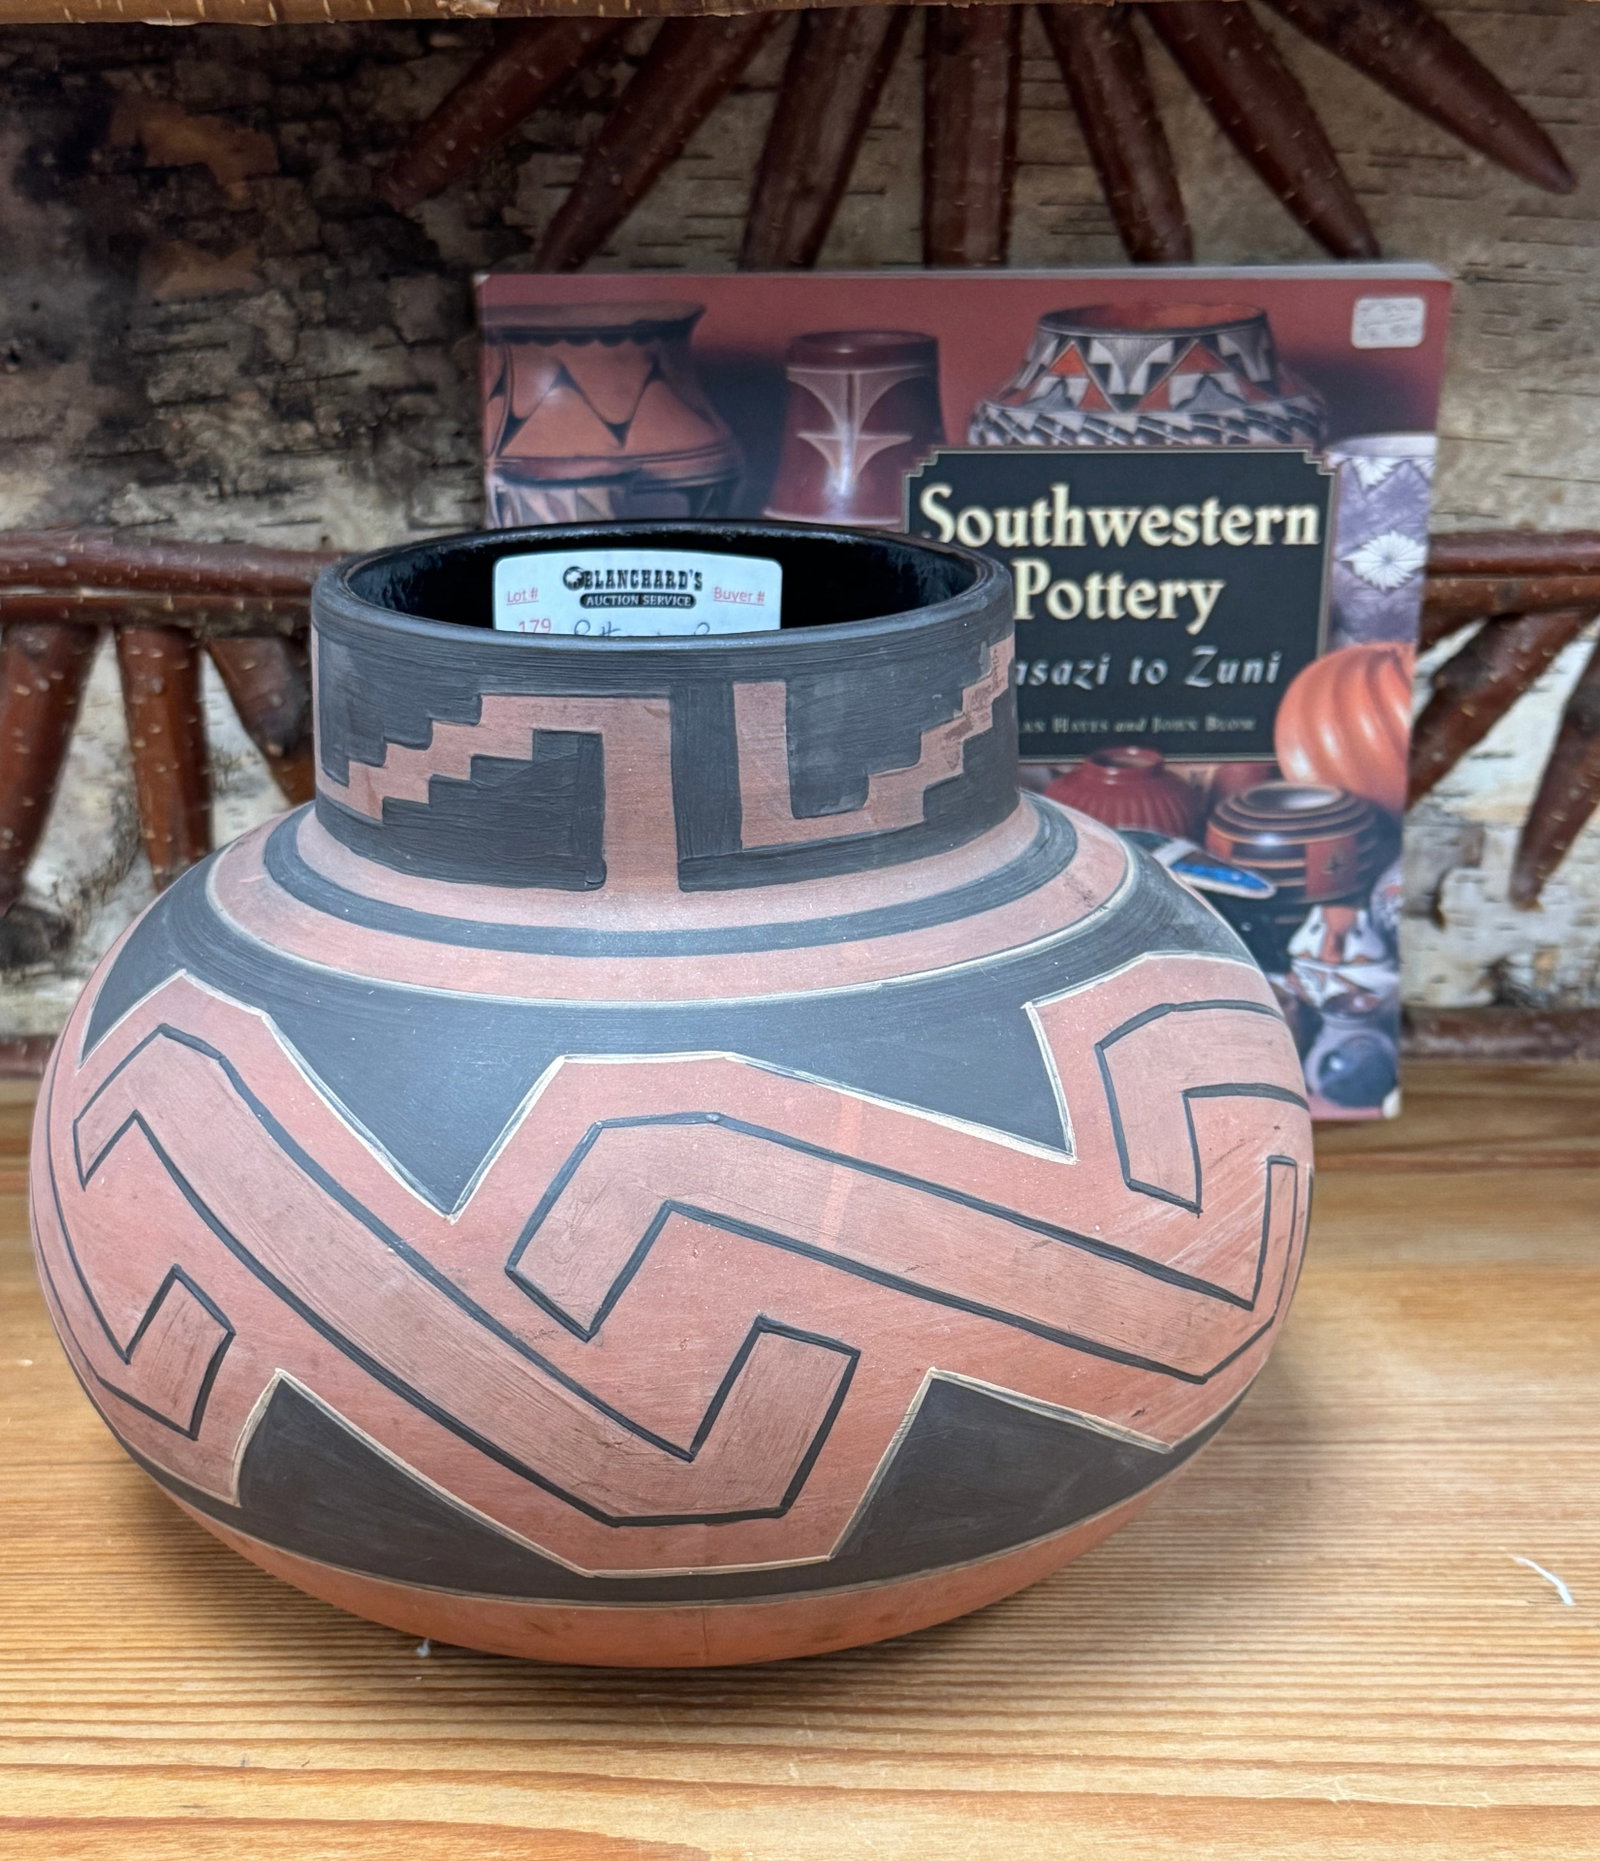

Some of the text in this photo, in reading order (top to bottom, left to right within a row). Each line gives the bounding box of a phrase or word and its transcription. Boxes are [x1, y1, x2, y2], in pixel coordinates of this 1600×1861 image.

[920, 482, 1320, 548] Southwestern
[583, 569, 703, 592] BLANCHARD'S
[507, 587, 538, 603] Lot #
[586, 595, 692, 606] AUCTION SERVICE
[714, 586, 765, 604] Buyer #
[1012, 557, 1225, 635] Pottery
[518, 617, 552, 634] 179
[1128, 656, 1169, 686] to
[1184, 644, 1284, 689] Zuni
[1113, 715, 1147, 733] and
